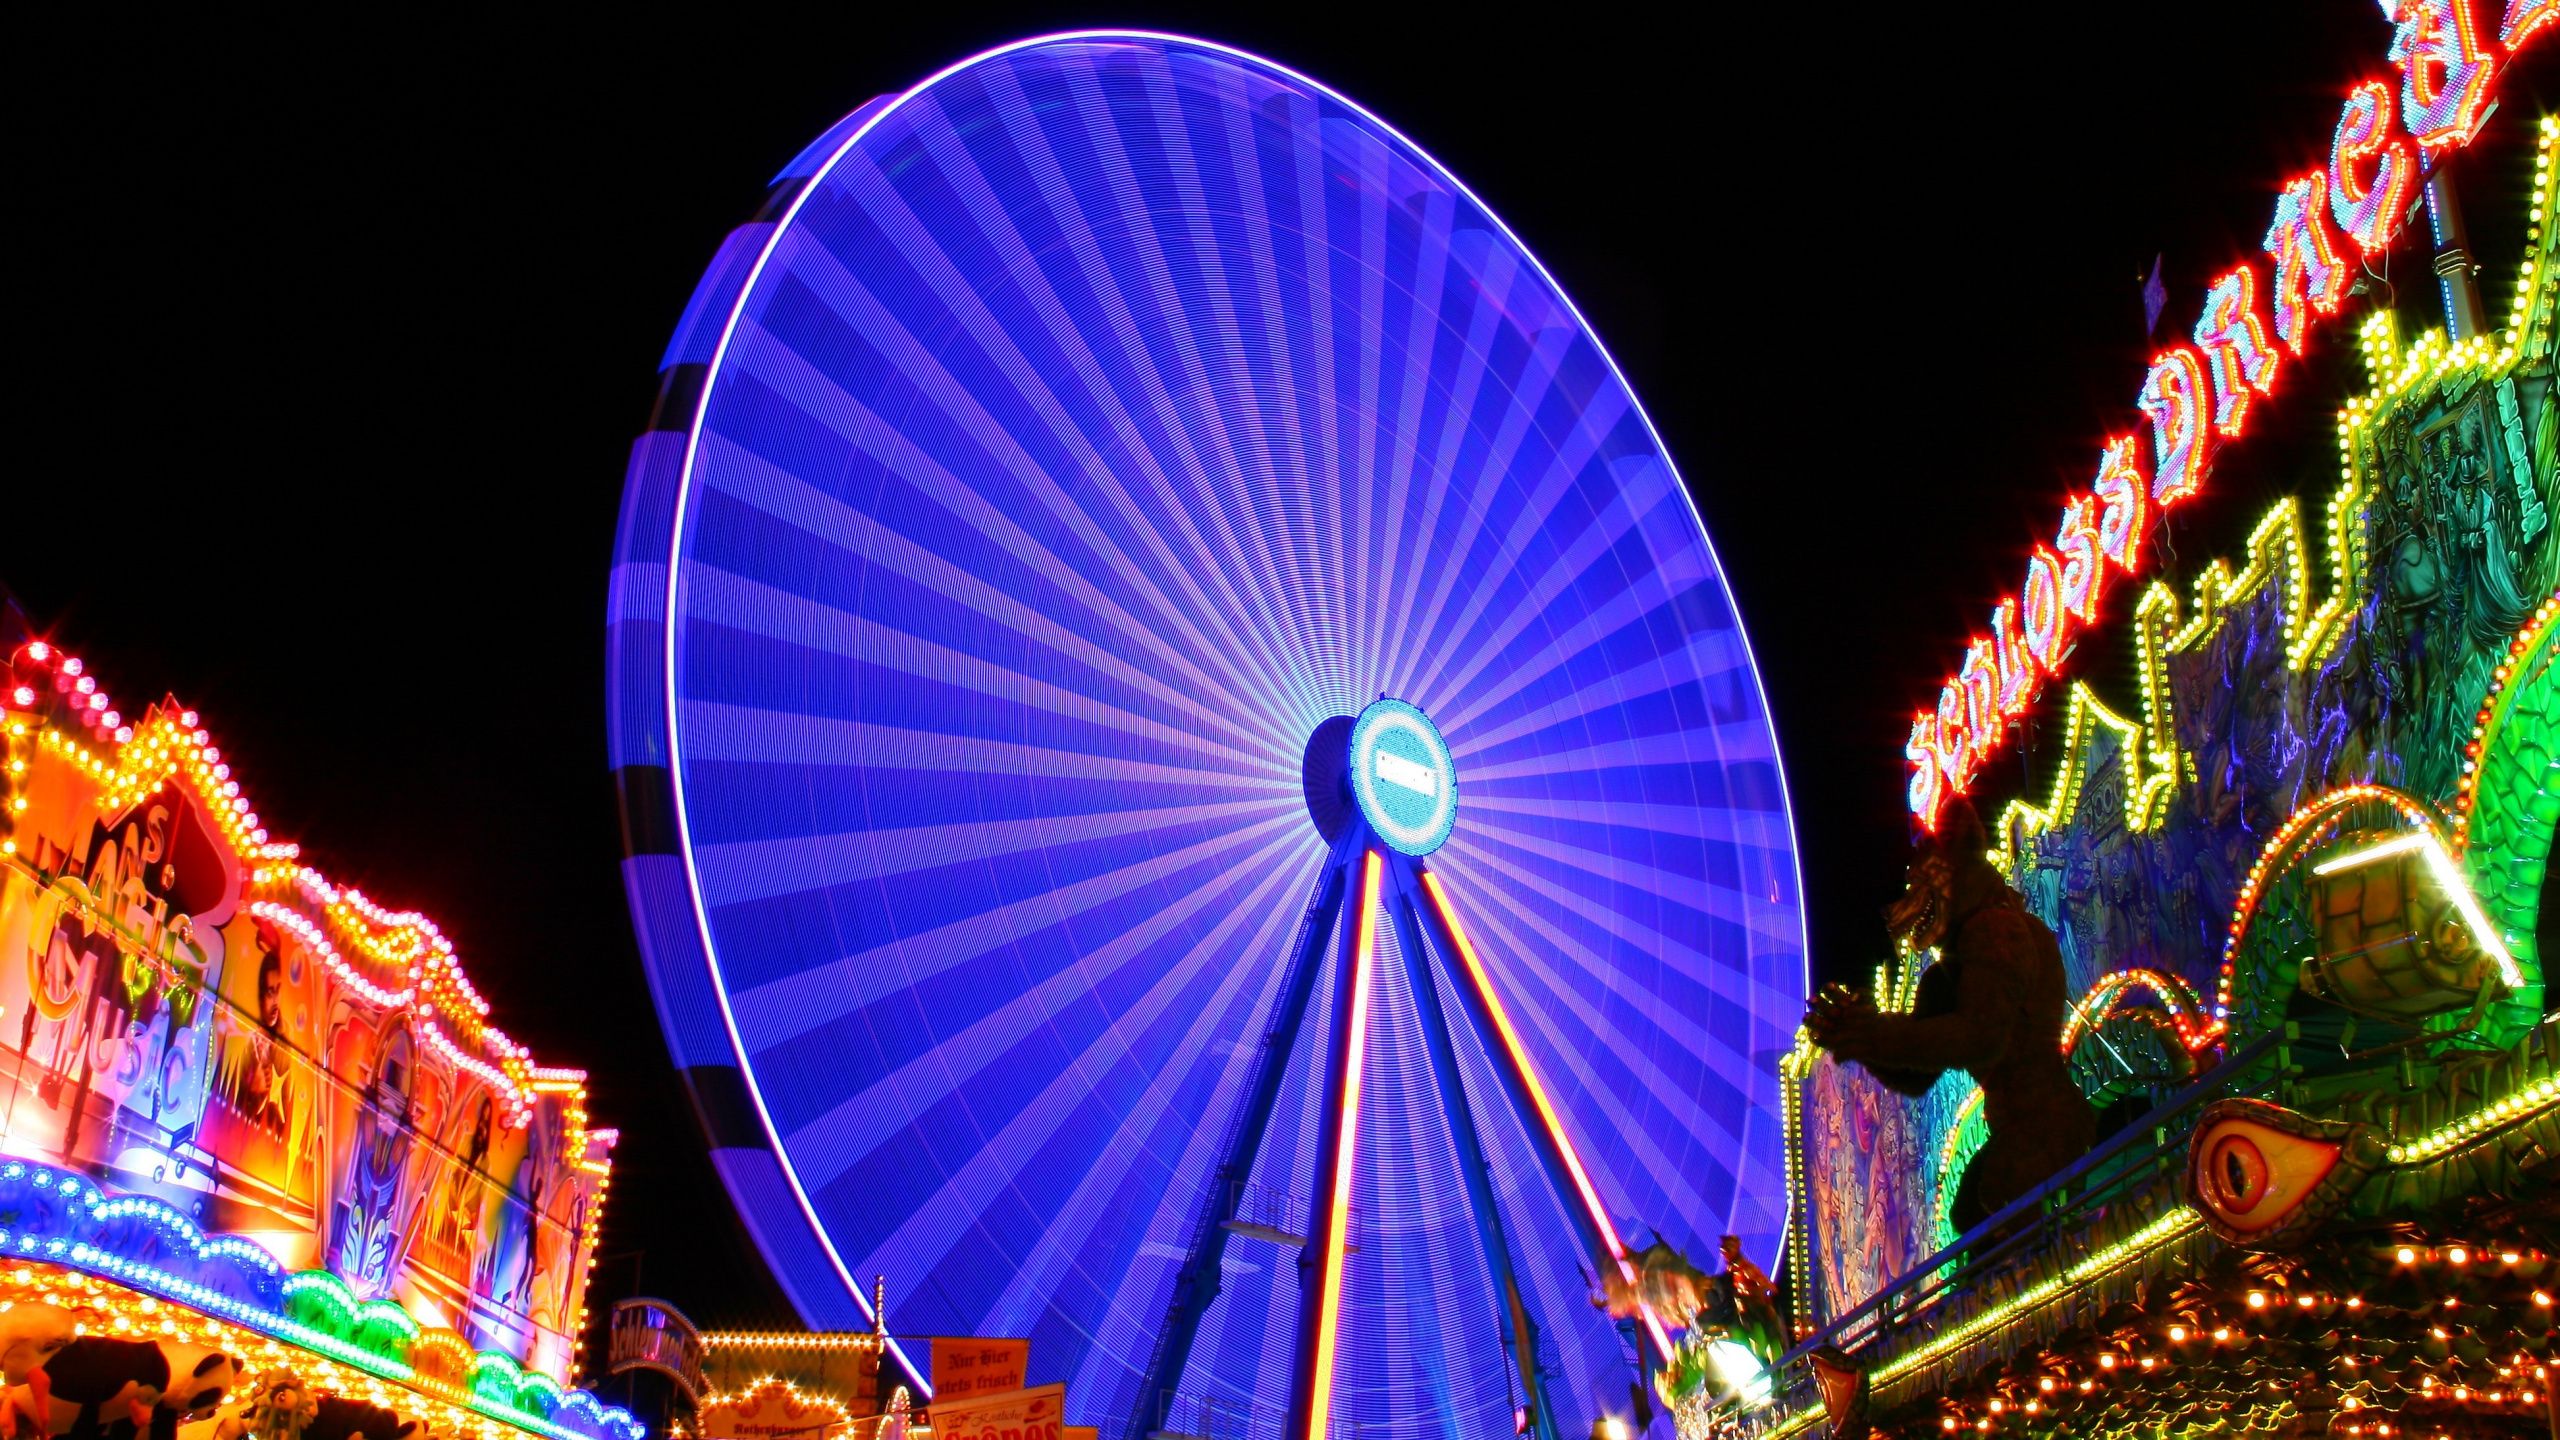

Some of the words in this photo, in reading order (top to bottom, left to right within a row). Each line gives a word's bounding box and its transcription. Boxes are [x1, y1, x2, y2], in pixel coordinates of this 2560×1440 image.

[1905, 436, 2145, 833] SCHLOSS
[31, 928, 187, 1114] MUSIC
[936, 1378, 972, 1395] stets
[976, 1371, 1018, 1390] frisch
[947, 1353, 976, 1370] Nur
[980, 1349, 1011, 1367] Hier
